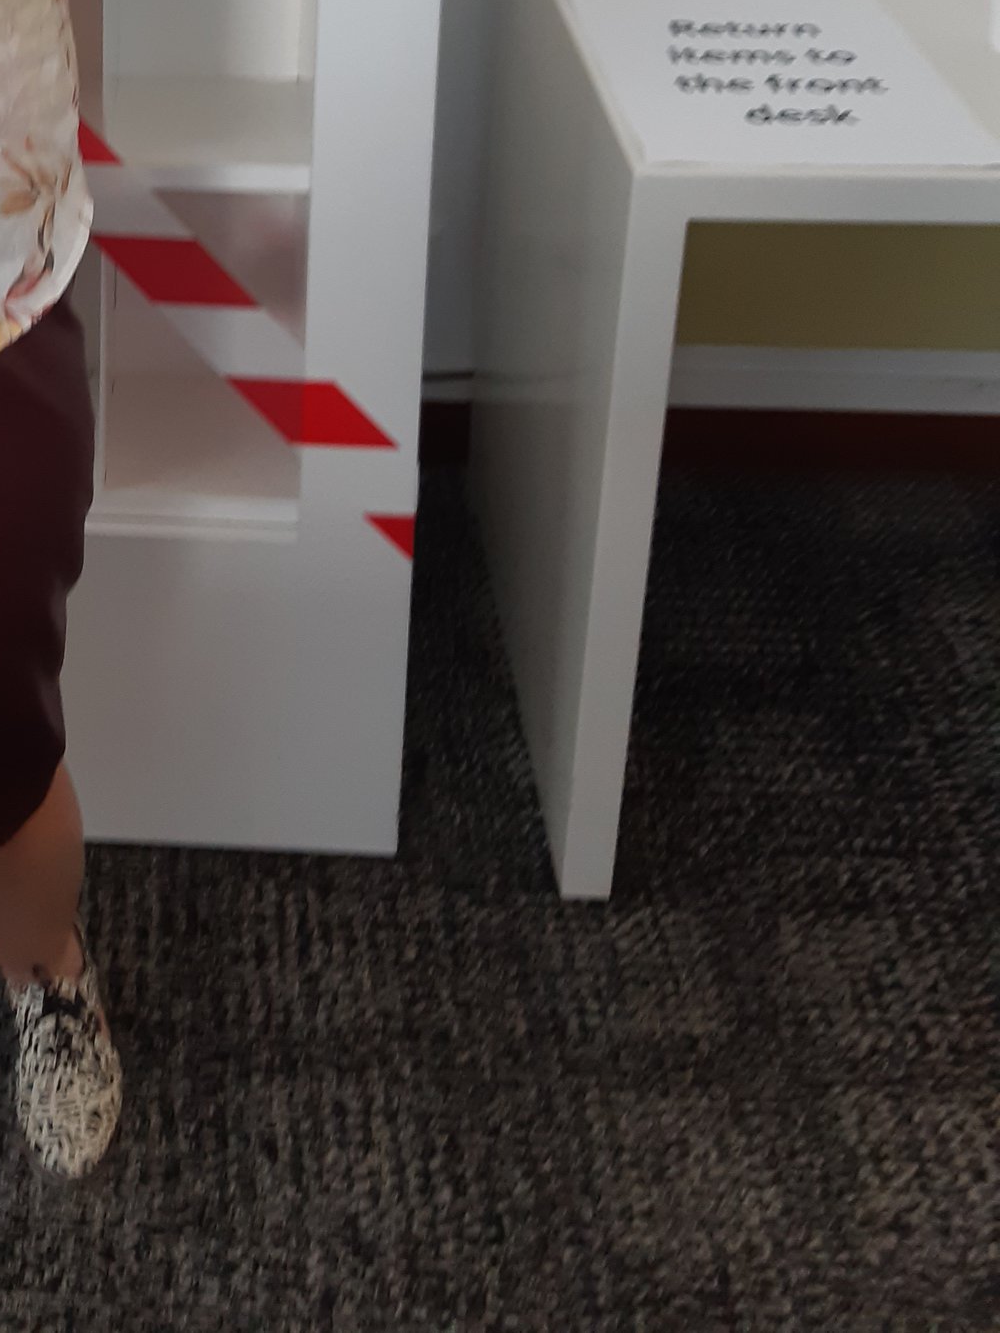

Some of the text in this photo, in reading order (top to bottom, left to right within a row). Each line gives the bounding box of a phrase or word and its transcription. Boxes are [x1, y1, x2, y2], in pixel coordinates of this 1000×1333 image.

[667, 18, 823, 39] Return
[666, 44, 858, 65] items to
[673, 72, 890, 94] the front
[745, 104, 861, 126] desk
